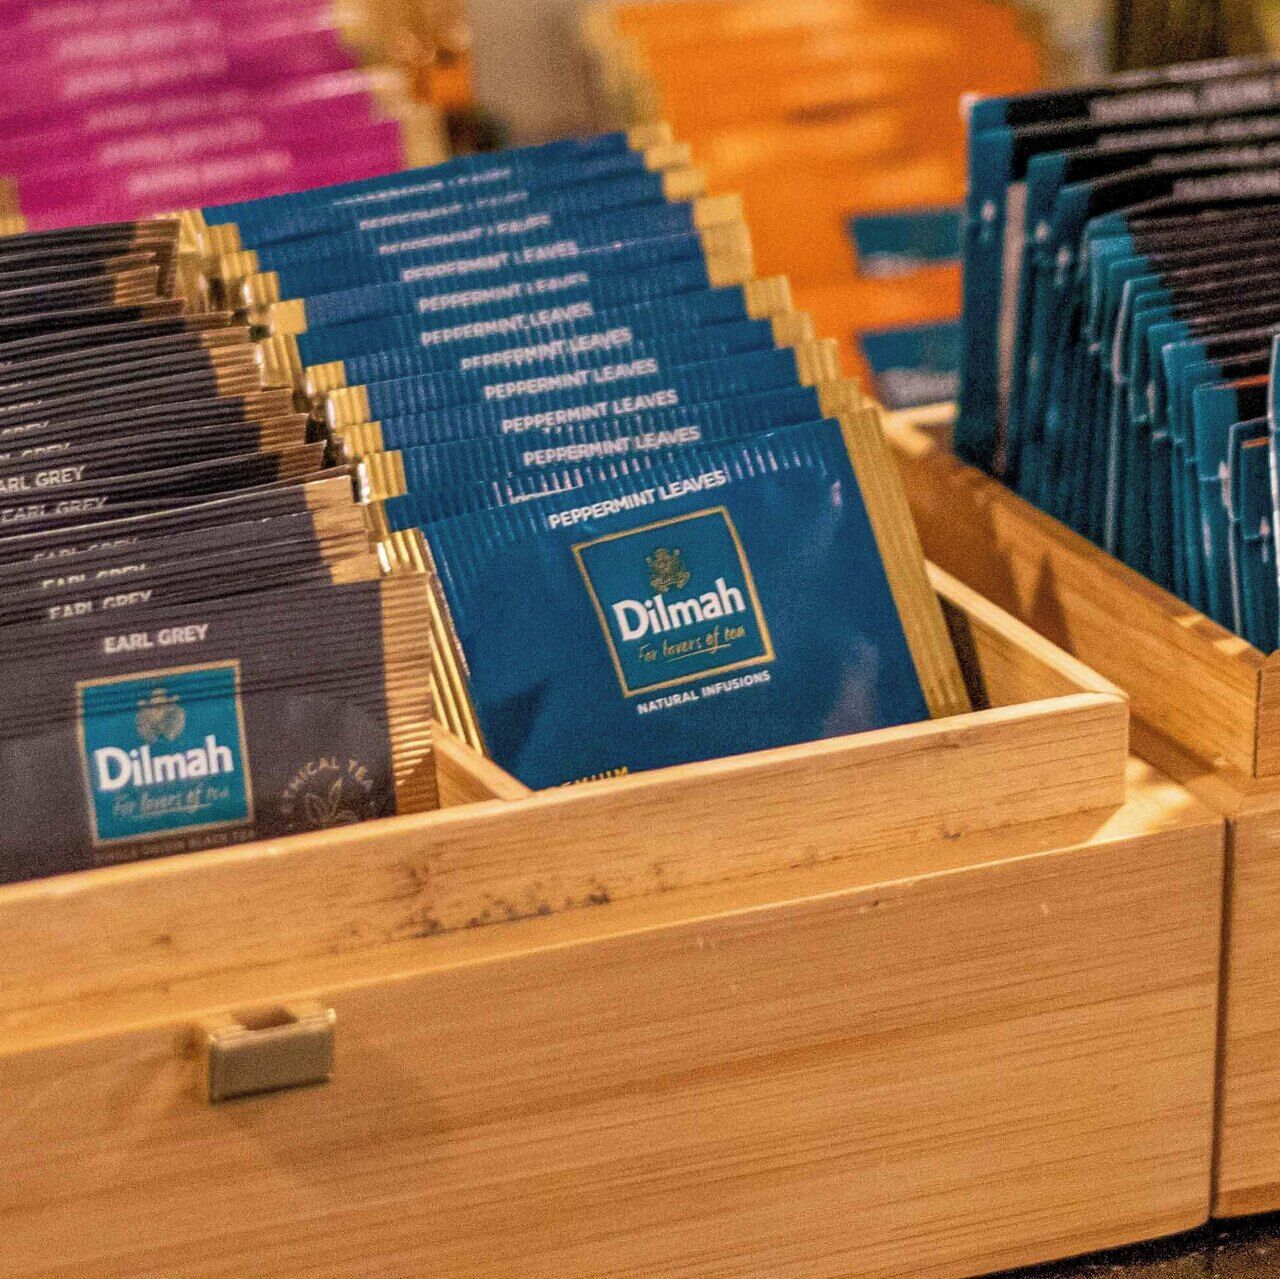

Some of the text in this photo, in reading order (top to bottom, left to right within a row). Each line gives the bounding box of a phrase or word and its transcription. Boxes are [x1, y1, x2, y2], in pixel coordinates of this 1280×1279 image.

[420, 301, 593, 346] PEPPERMINT LEAVES
[460, 326, 632, 370] PEPPERMINT LEAVES
[484, 358, 658, 401] PEPPERMINT LEAVES
[502, 389, 678, 433] PEPPERMINT LEAVES
[523, 425, 701, 466] PEPPERMINT LEAVES
[35, 465, 87, 487] GREY
[0, 495, 109, 524] EARL GREY
[548, 469, 727, 529] PEPPERMINT LEAVES
[612, 577, 746, 641] Dilmah
[104, 623, 209, 654] EARL GREY
[638, 625, 746, 663] For lovers of tea
[637, 670, 771, 715] NATURAL INFUSIONS
[93, 734, 234, 792] Dilmah
